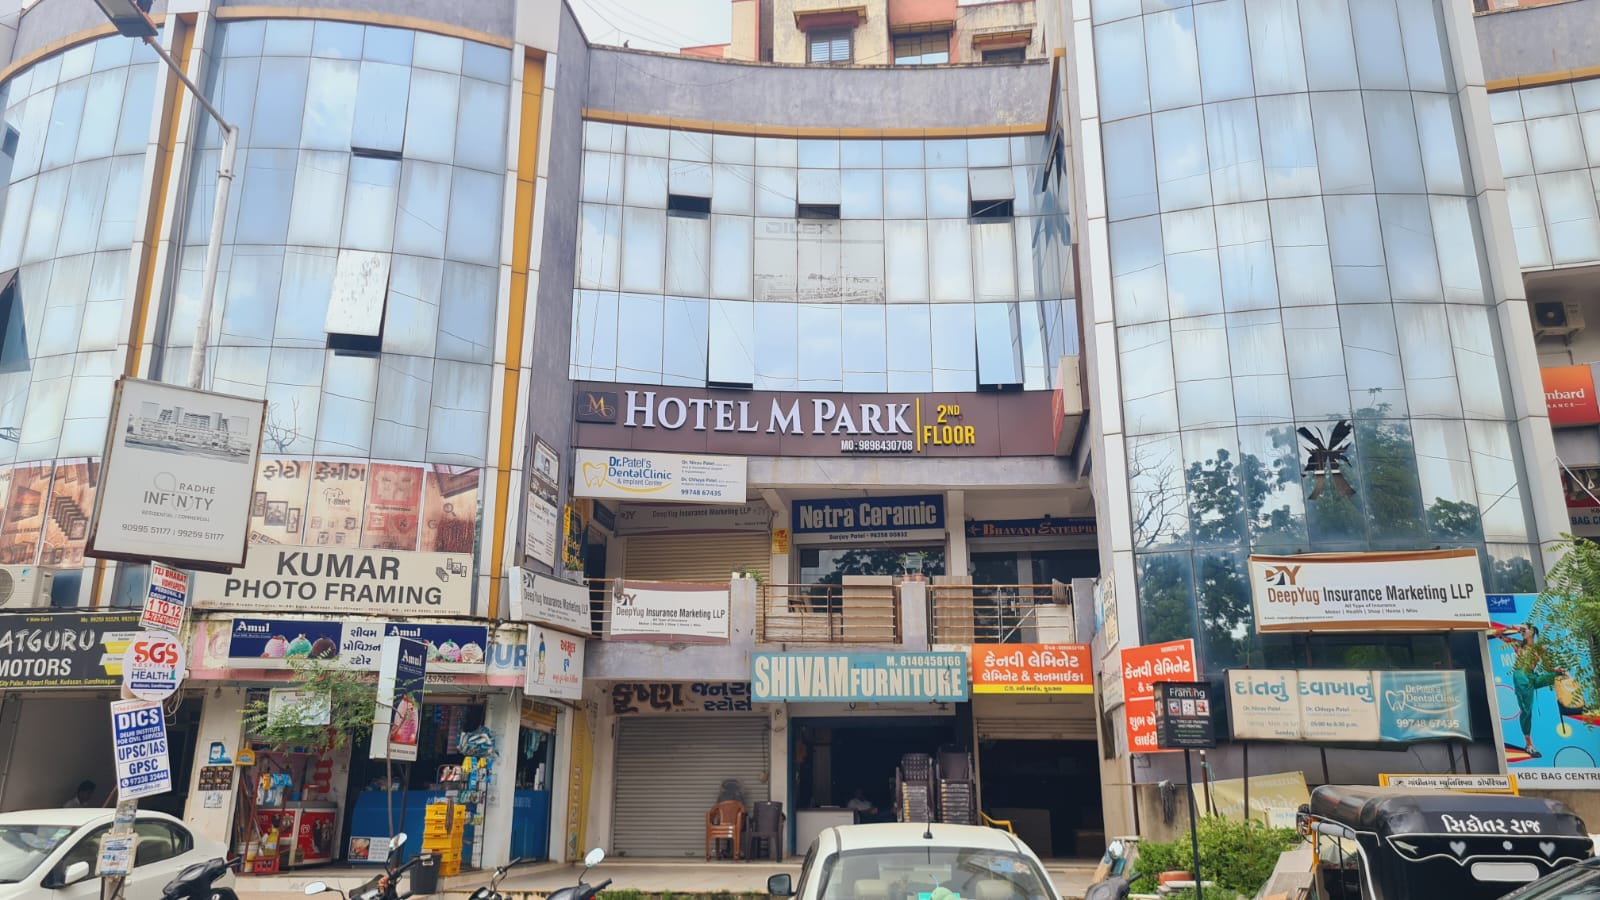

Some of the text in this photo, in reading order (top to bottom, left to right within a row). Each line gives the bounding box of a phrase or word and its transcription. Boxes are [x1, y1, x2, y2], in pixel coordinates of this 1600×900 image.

[624, 390, 914, 435] HOTEL M PARK
[936, 404, 960, 424] 2ND
[923, 425, 976, 445] FLOOR
[179, 483, 216, 494] RADHE
[680, 509, 707, 517] Insurance
[709, 508, 738, 516] Marketing
[800, 501, 936, 528] Netra Ceramic
[122, 523, 149, 533] 90995
[151, 526, 171, 535] 51177
[205, 532, 224, 541] 51177
[983, 524, 1036, 535] BHAVANI
[277, 551, 400, 580] KUMAR
[165, 569, 187, 583] BHARAT
[224, 579, 442, 605] PHOTO FRAMING
[1267, 583, 1474, 605] DeepYug Insurance Marketing LLP
[149, 599, 182, 617] 1 TO 12
[542, 593, 562, 608] Insurance
[562, 598, 582, 616] Marketing
[616, 606, 725, 620] DeepYug Insurance Marketing LLP
[236, 621, 270, 632] Amul
[350, 627, 377, 637] શીવમ
[389, 625, 421, 637] Amul
[134, 641, 178, 665] SGS
[343, 640, 381, 651] પ્રોવિઝન
[401, 649, 422, 667] Amul
[886, 656, 898, 666] M.
[984, 650, 1080, 668] કેનવી લેમિનેટ
[755, 656, 963, 697] SHIVAM FURNITURE
[982, 670, 1018, 682] લેમિનેટ
[1021, 670, 1030, 682] &
[1125, 656, 1191, 679] કેનવી લેમિનેટ
[1170, 688, 1206, 699] Framing
[118, 709, 159, 730] DICS
[119, 726, 160, 738] DELHI INSTITUTE
[142, 732, 163, 740] SERVICES
[118, 740, 165, 761] UPSC/IAS
[129, 758, 158, 775] GPSC
[1517, 772, 1538, 780] KBC
[1541, 772, 1562, 780] BAG
[1441, 814, 1541, 834] સિકોતર રાજ
